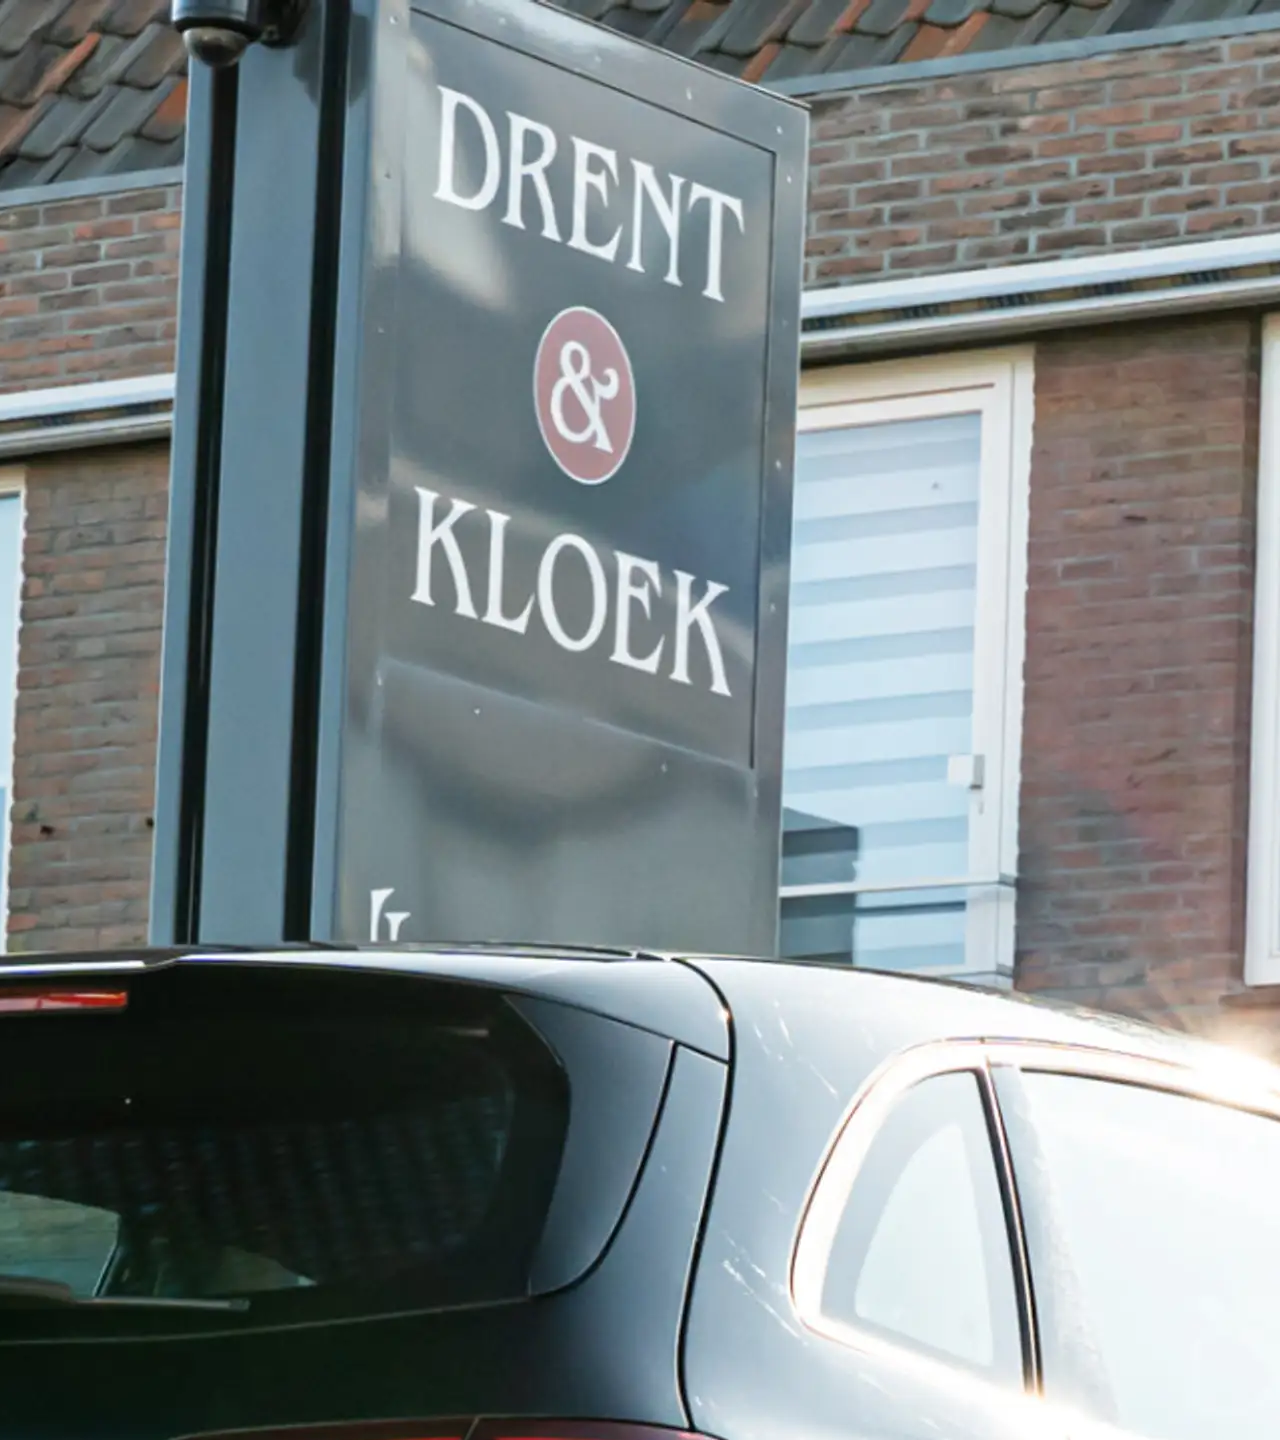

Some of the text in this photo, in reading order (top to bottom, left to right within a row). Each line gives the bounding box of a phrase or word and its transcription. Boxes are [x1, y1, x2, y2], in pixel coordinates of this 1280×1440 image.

[433, 84, 745, 303] DRENT
[550, 340, 619, 454] &
[410, 486, 732, 697] KLOEK
